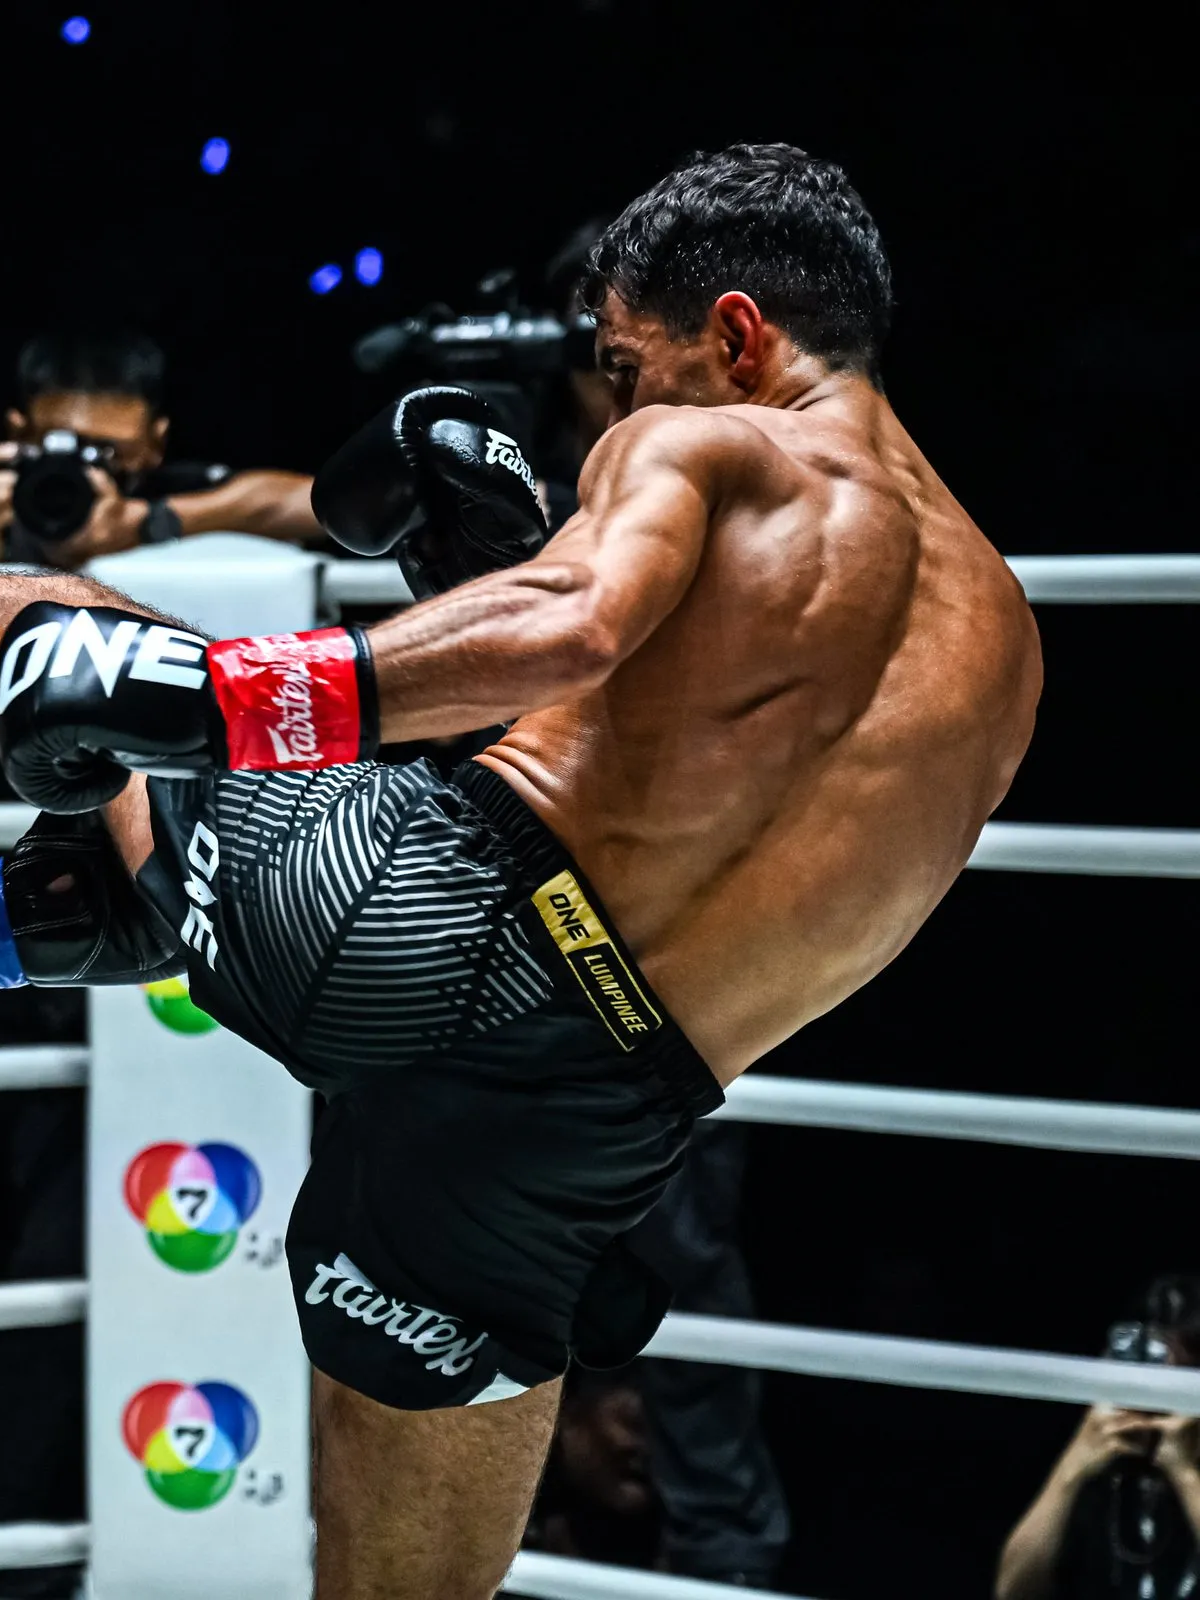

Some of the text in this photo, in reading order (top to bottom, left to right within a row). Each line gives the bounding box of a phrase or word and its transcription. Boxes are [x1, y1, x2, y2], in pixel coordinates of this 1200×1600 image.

[548, 892, 649, 1034] ONE LUMPINEE
[176, 1186, 209, 1222] 7
[304, 1252, 489, 1376] Fairtex
[173, 1425, 206, 1460] 7
